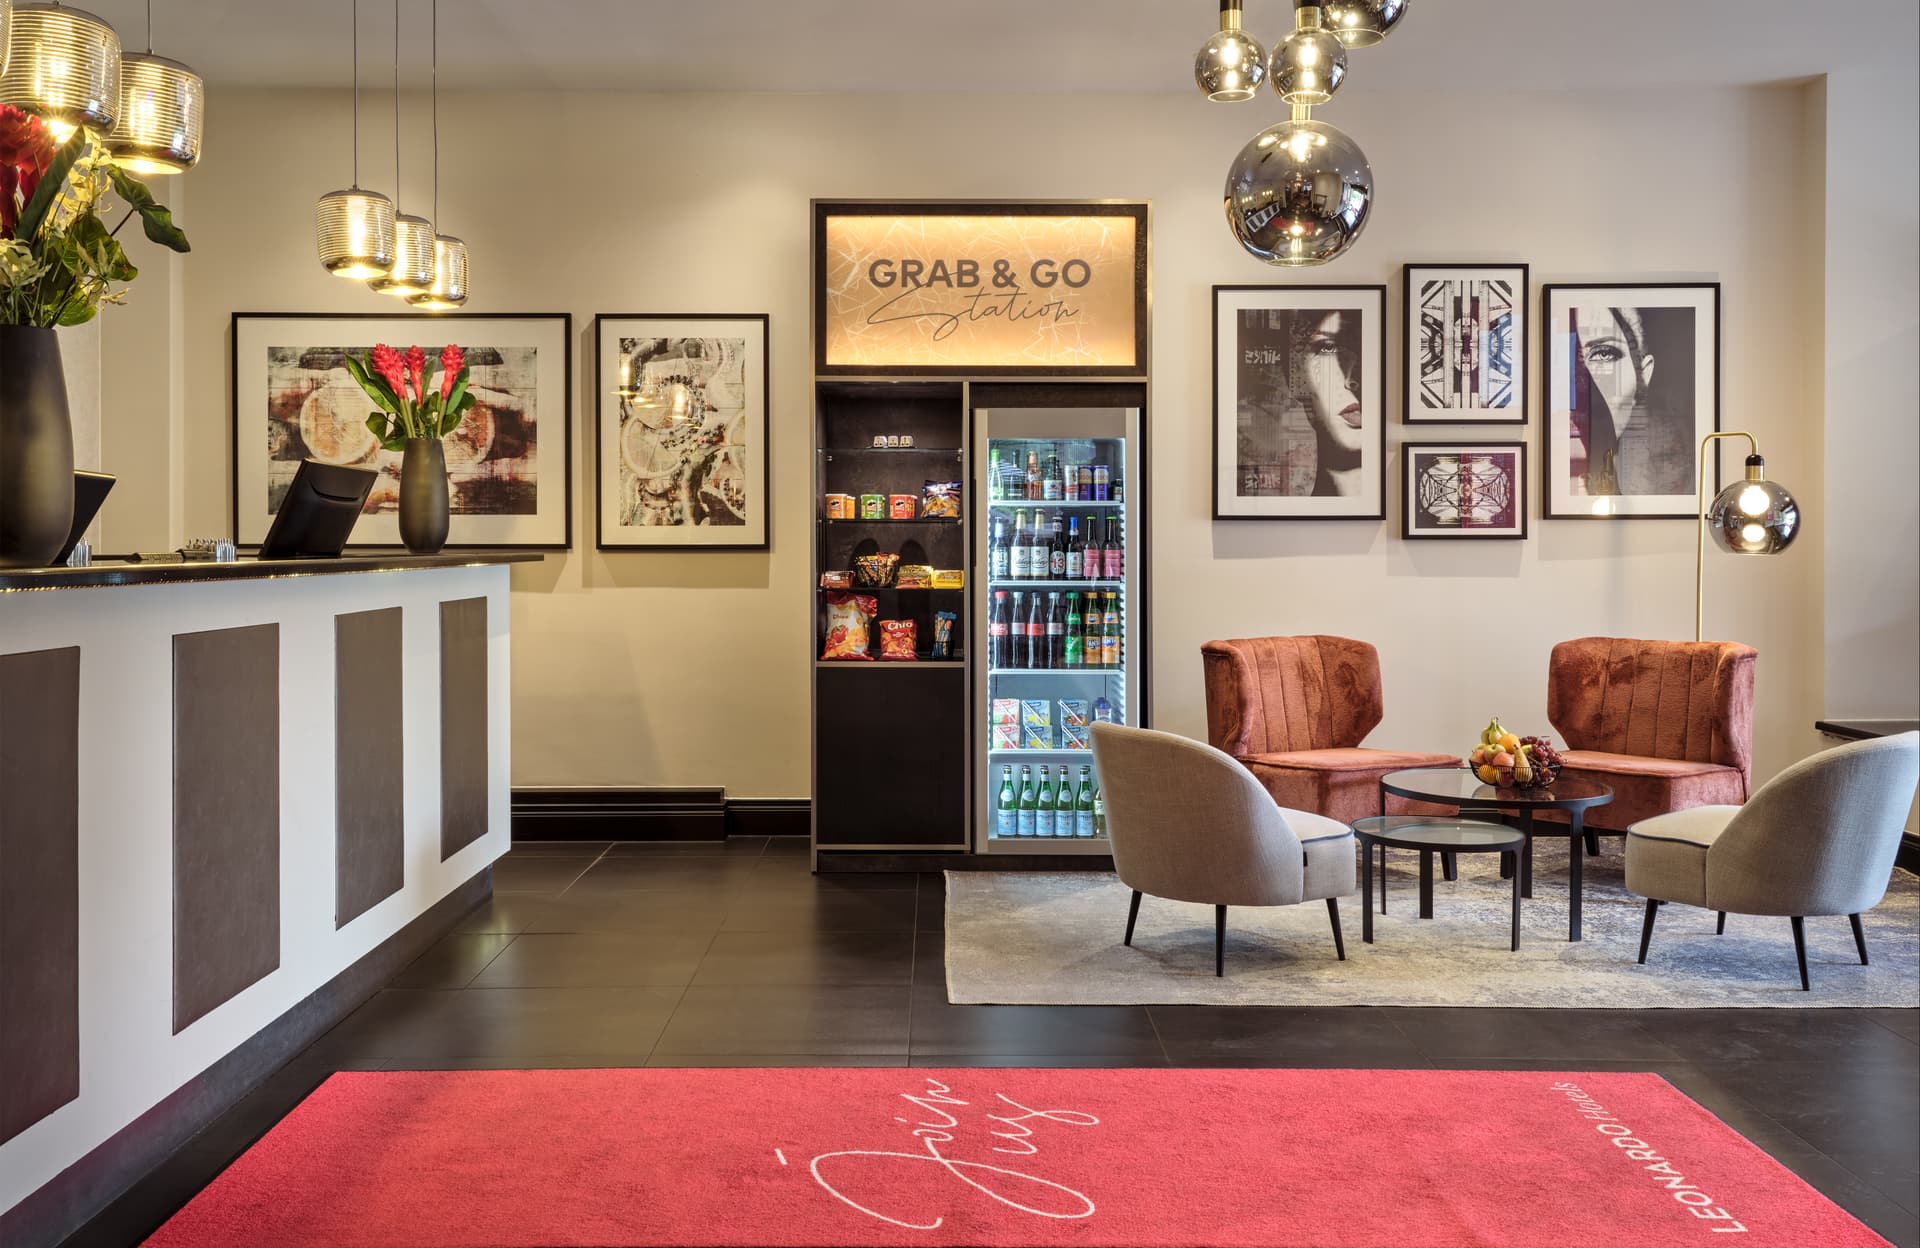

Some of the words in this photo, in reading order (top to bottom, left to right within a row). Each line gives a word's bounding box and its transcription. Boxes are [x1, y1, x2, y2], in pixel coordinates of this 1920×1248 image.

[868, 258, 980, 289] GRAB
[991, 259, 1018, 289] &
[1030, 258, 1092, 289] GO
[866, 270, 1080, 342] Station
[887, 622, 913, 631] Chio
[1550, 1081, 1618, 1122] Hotels
[774, 1078, 1096, 1230] Join
[1596, 1123, 1749, 1233] LEONARDO
